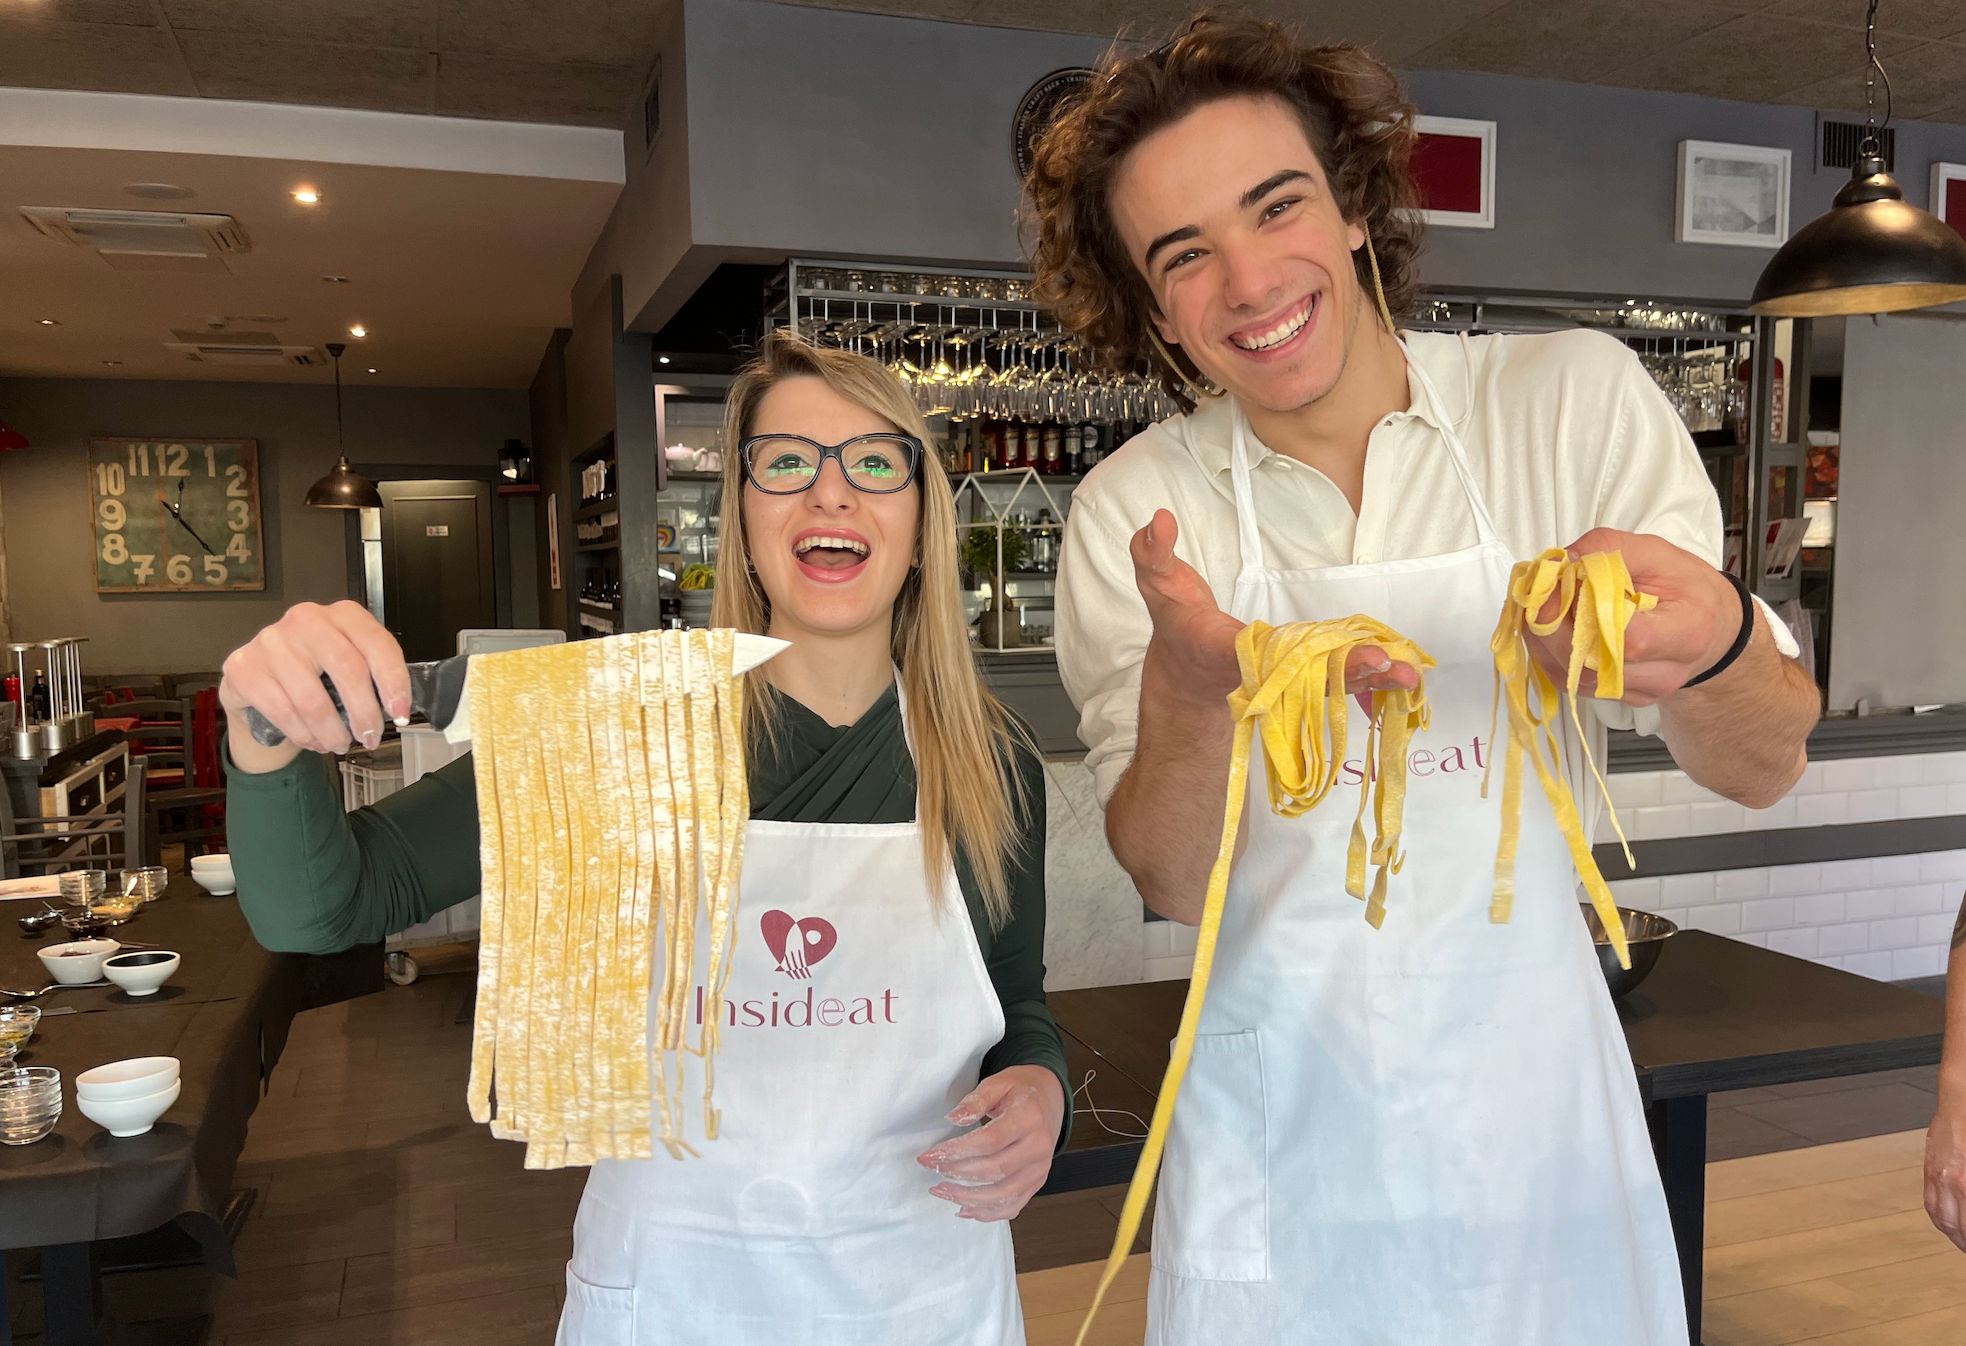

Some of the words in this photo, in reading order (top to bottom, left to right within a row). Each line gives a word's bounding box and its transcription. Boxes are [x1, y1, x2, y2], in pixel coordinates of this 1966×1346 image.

[128, 444, 150, 476] 11
[155, 444, 191, 476] 12
[204, 444, 216, 477] 1
[96, 462, 126, 496] 10
[225, 464, 249, 497] 2
[99, 498, 127, 531] 9
[227, 499, 250, 532] 3
[102, 533, 129, 565] 8
[226, 533, 252, 564] 4
[131, 554, 155, 585] 7
[166, 554, 193, 585] 6
[203, 554, 228, 585] 5
